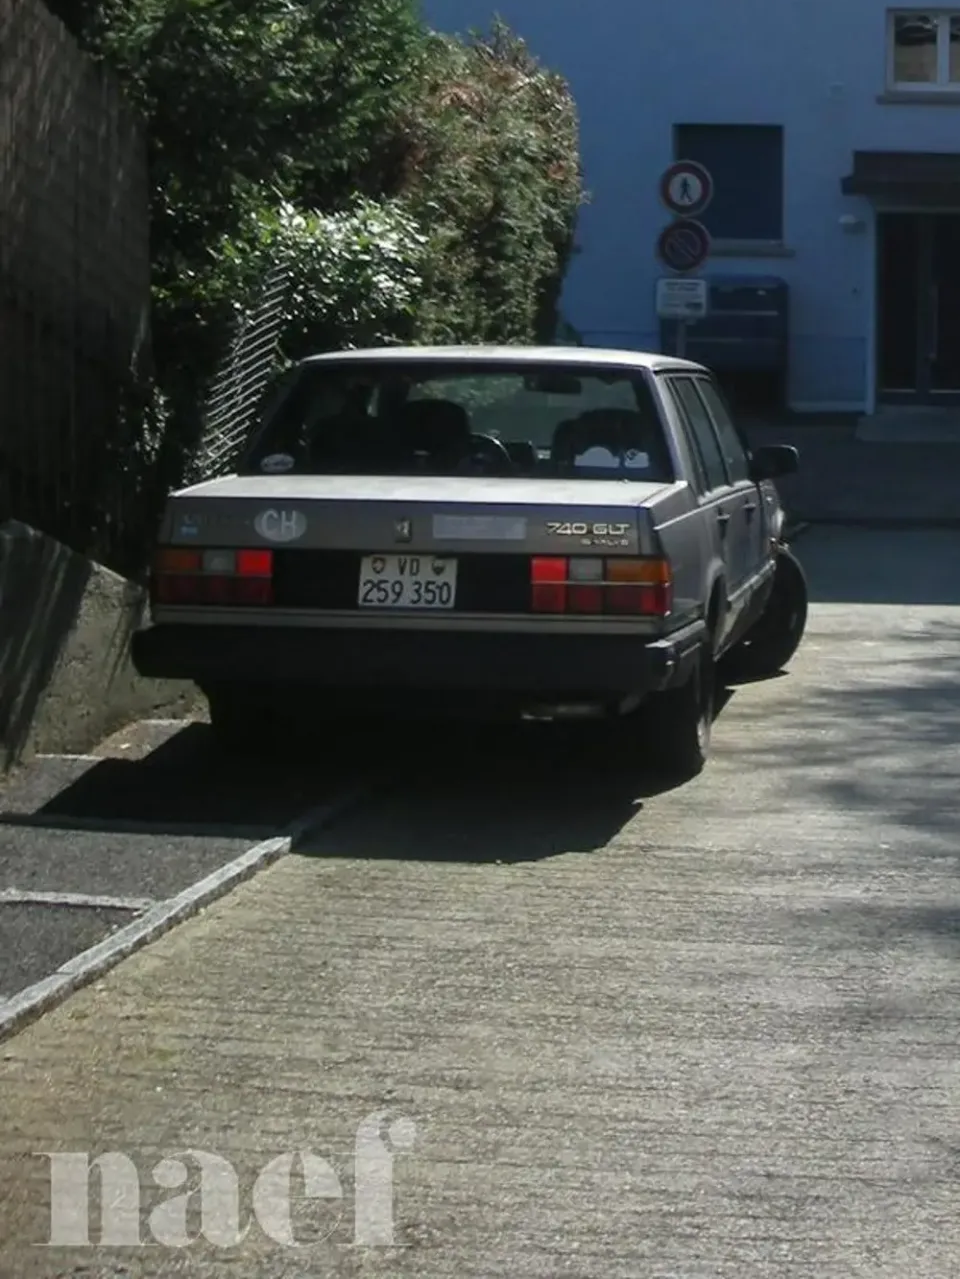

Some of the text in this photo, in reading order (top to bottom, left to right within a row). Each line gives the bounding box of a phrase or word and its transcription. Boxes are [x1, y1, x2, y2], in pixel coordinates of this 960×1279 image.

[260, 508, 297, 538] CH
[546, 521, 631, 536] 740 GLT
[397, 557, 420, 577] VD
[361, 578, 452, 606] 259 350
